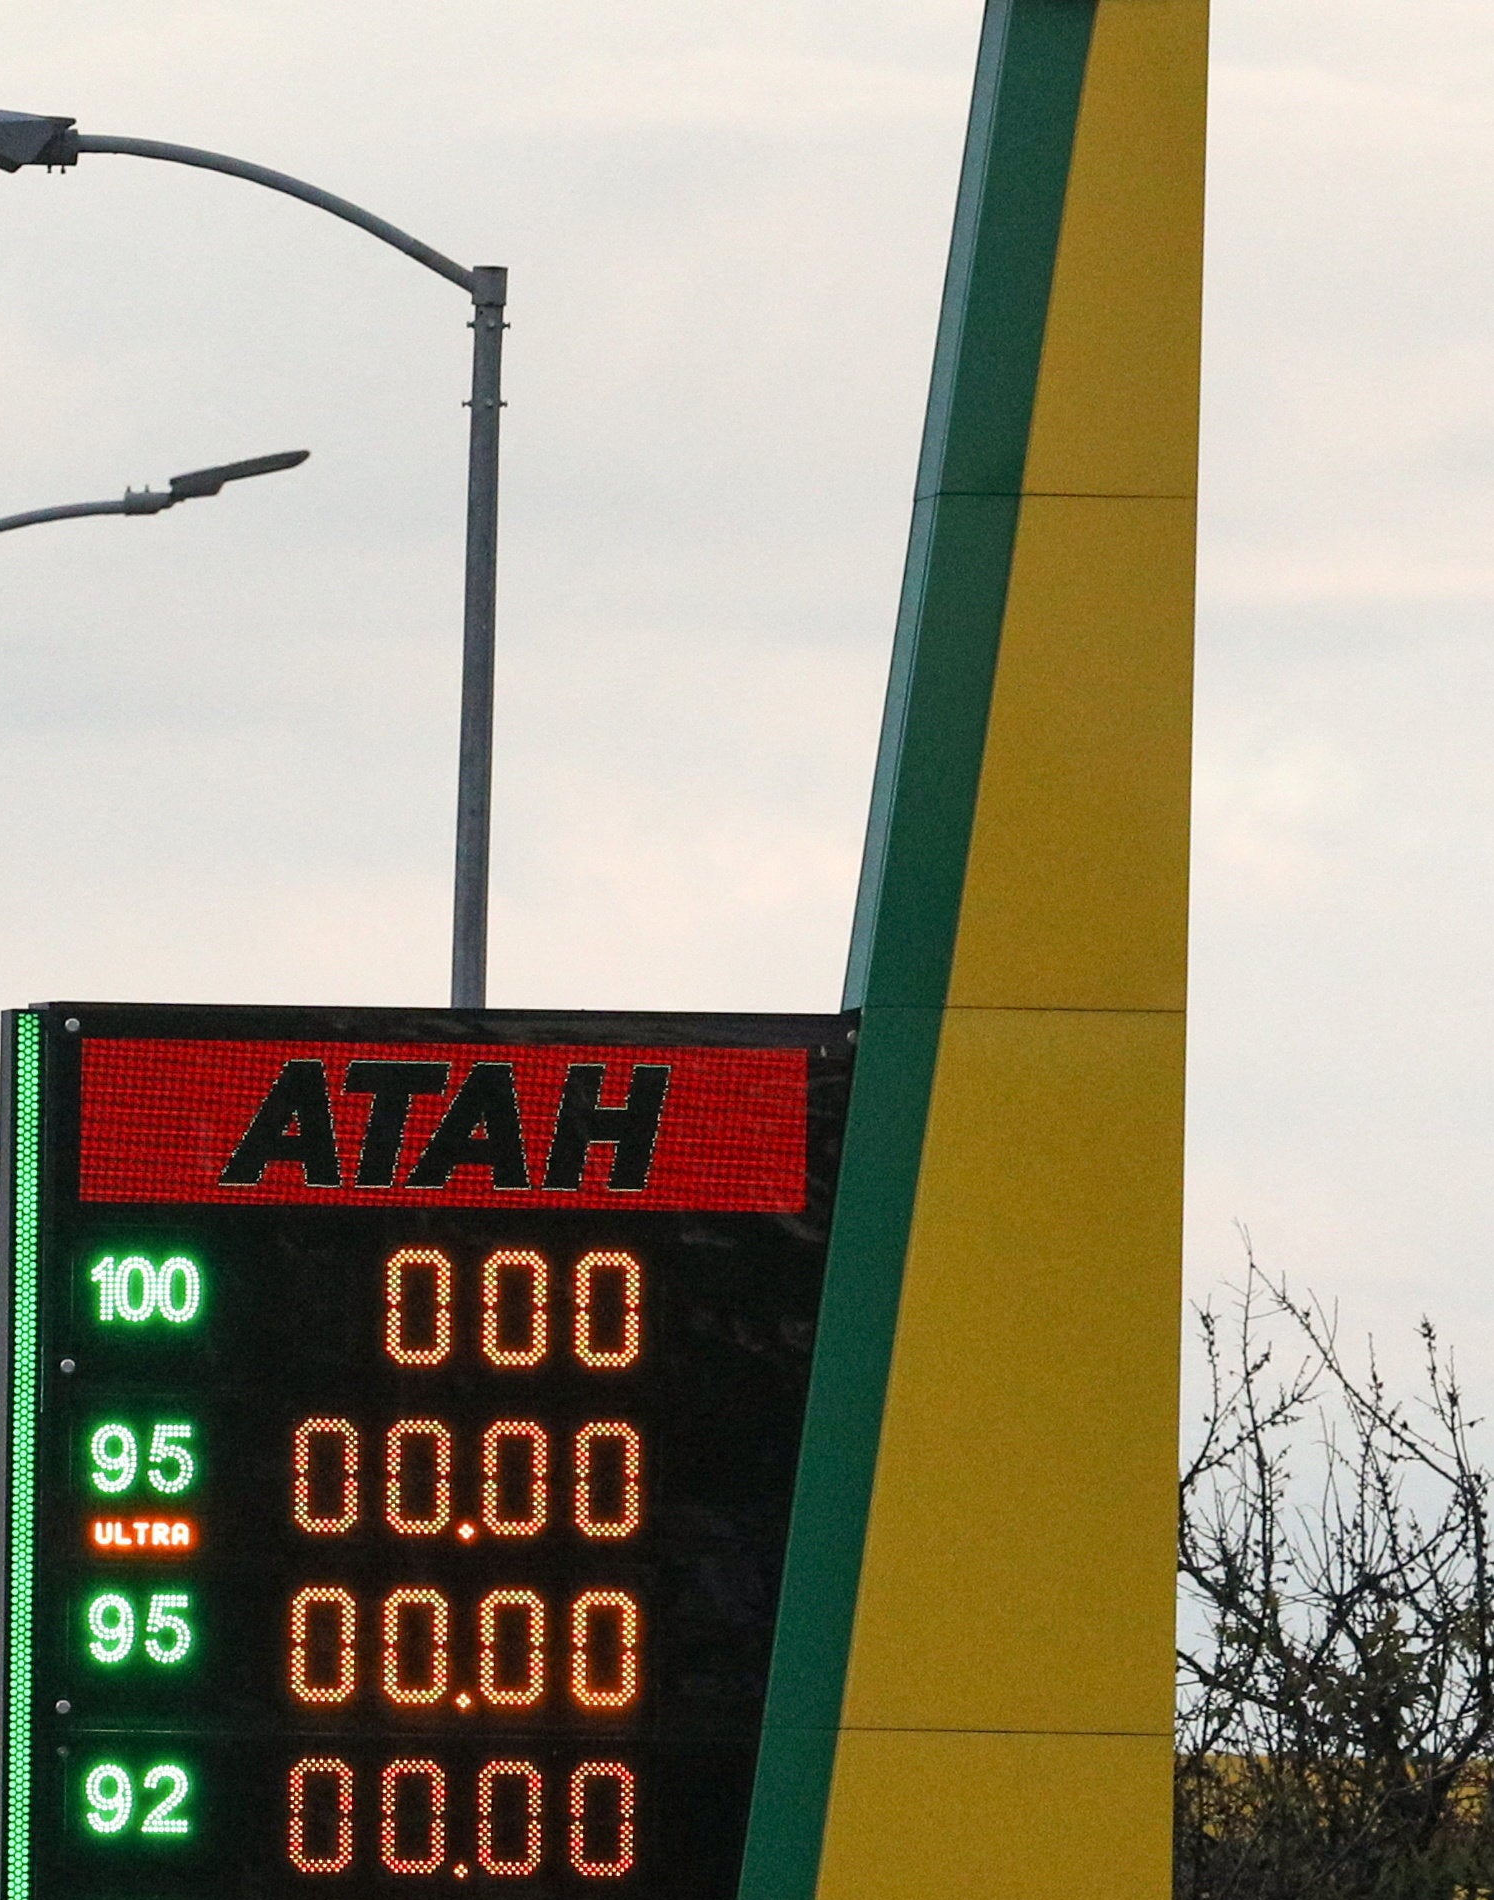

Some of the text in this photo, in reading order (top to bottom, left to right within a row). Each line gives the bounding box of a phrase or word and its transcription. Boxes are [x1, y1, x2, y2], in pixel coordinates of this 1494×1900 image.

[219, 1059, 671, 1191] АТАН
[91, 1256, 200, 1323] 100
[91, 1418, 640, 1537] 95 00.00
[94, 1521, 190, 1546] ULTRA
[88, 1587, 639, 1708] 95 00.00
[84, 1757, 635, 1878] 92 00.00
